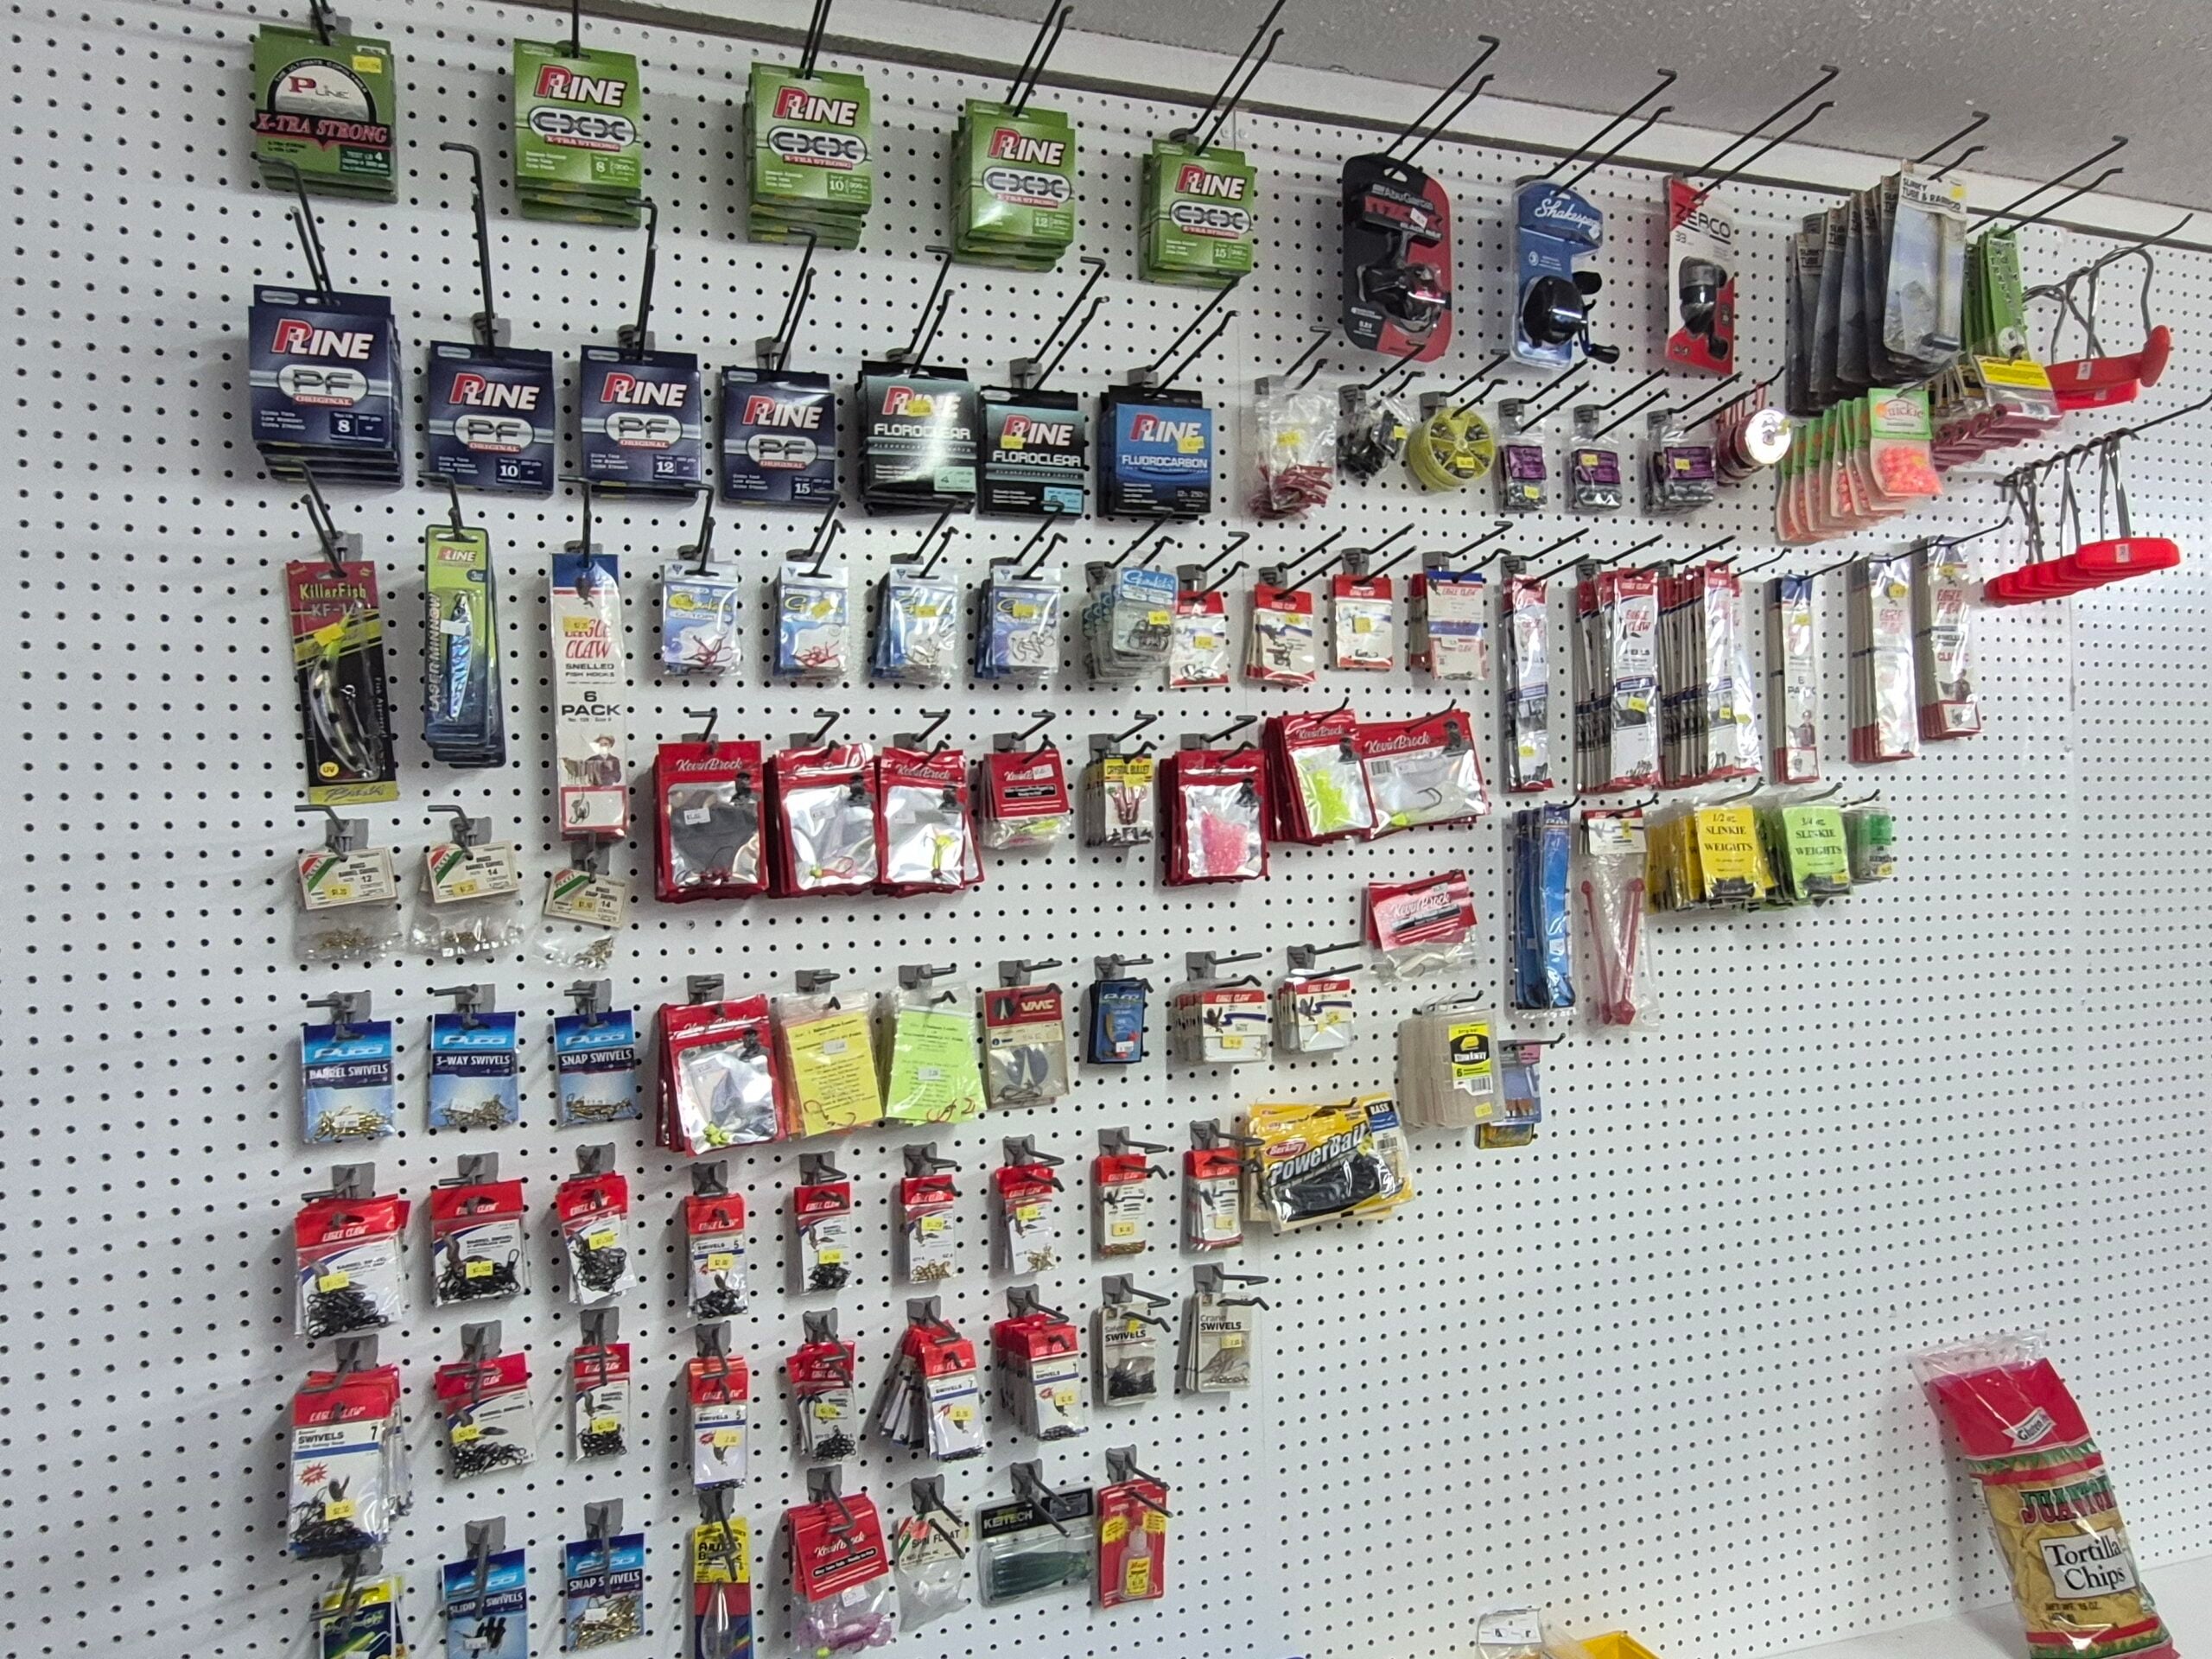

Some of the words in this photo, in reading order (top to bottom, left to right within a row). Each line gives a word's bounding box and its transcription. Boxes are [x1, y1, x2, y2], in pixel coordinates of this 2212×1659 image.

[257, 113, 311, 134] X-TRA
[316, 119, 388, 143] STRONG
[829, 182, 845, 192] 10
[292, 369, 353, 395] PF
[467, 419, 521, 442] PF
[618, 416, 670, 439] PF
[758, 438, 806, 460] PF
[992, 449, 1082, 467] FLOROCLEAR
[1122, 454, 1208, 468] FLUOROCARBON
[499, 464, 518, 478] 10
[656, 461, 675, 474] 12
[794, 483, 810, 495] 15
[299, 582, 368, 601] KillerFish
[429, 594, 442, 660] MINNOW
[564, 640, 612, 659] CLAW
[583, 690, 597, 702] 6
[561, 704, 620, 716] PACK
[1705, 825, 1747, 836] SLINKIE
[1704, 842, 1753, 853] WEIGHTS
[1795, 846, 1842, 856] WEIGHTS
[1020, 999, 1056, 1012] VMC
[435, 1055, 466, 1068] 3-WAY
[467, 1055, 511, 1067] SWIVELS
[561, 1053, 589, 1067] SNAP
[589, 1051, 633, 1064] SWIVELS
[309, 1068, 346, 1081] BARREL
[346, 1064, 390, 1077] SWIVELS
[1370, 1103, 1390, 1116] BASS
[1267, 1122, 1370, 1186] PowerBait
[1268, 1141, 1306, 1157] Berkley
[345, 1224, 370, 1238] CLAW
[733, 1240, 740, 1250] 5
[1200, 1322, 1243, 1332] SWIVELS
[1105, 1329, 1147, 1343] SWIVELS
[309, 1409, 335, 1422] EAGL
[735, 1410, 742, 1421] 5
[298, 1432, 345, 1445] SWIVELS
[370, 1426, 378, 1441] 7
[982, 1509, 1034, 1529] KEITECH
[813, 1531, 867, 1559] KevinBock
[2044, 1535, 2124, 1567] Tortilla
[569, 1576, 598, 1592] SNAP
[2063, 1564, 2127, 1592] Chips
[486, 1592, 524, 1608] SWIVELS
